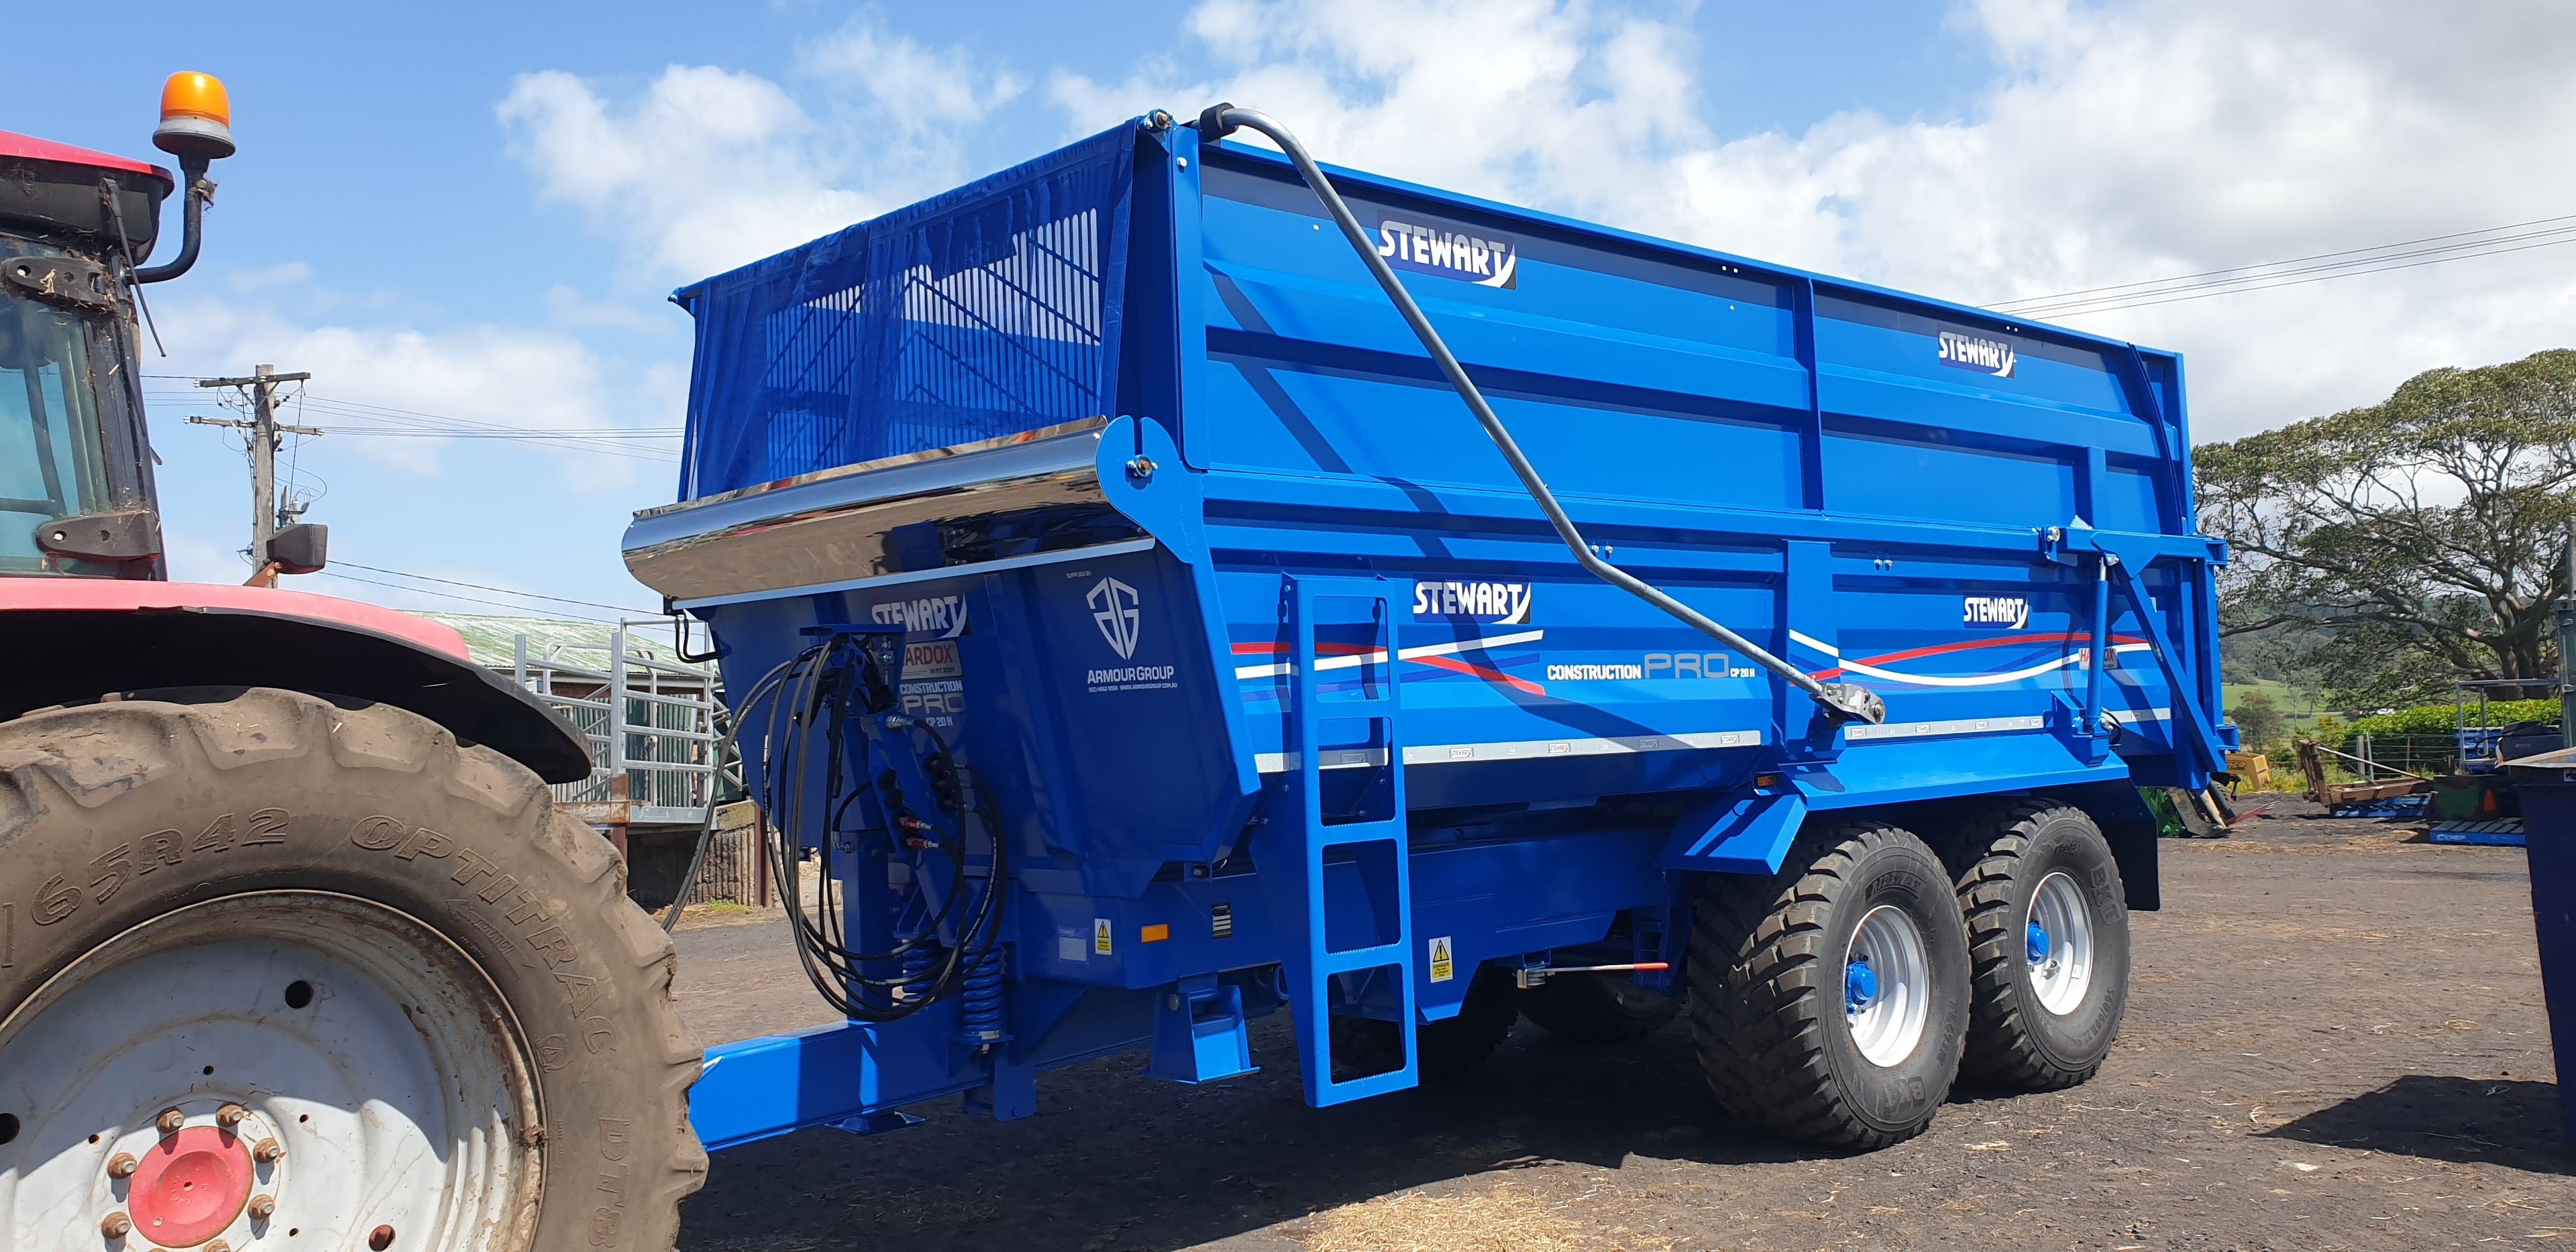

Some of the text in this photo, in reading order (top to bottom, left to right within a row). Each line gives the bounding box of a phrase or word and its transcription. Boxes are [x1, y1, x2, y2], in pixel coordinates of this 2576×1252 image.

[1379, 220, 1516, 288] STEWART
[1938, 331, 2014, 378] STEWART
[871, 593, 967, 638] STEWART
[1413, 581, 1531, 624] STEWART
[1963, 597, 2029, 629] STEWART
[904, 644, 954, 666] ARDOX
[1547, 665, 1642, 680] CONSTRUCTION
[1644, 653, 1729, 679] PRO
[900, 681, 963, 694] CONSTRUCTION
[902, 693, 966, 714] PRO
[350, 815, 617, 1054] OPTITRAC
